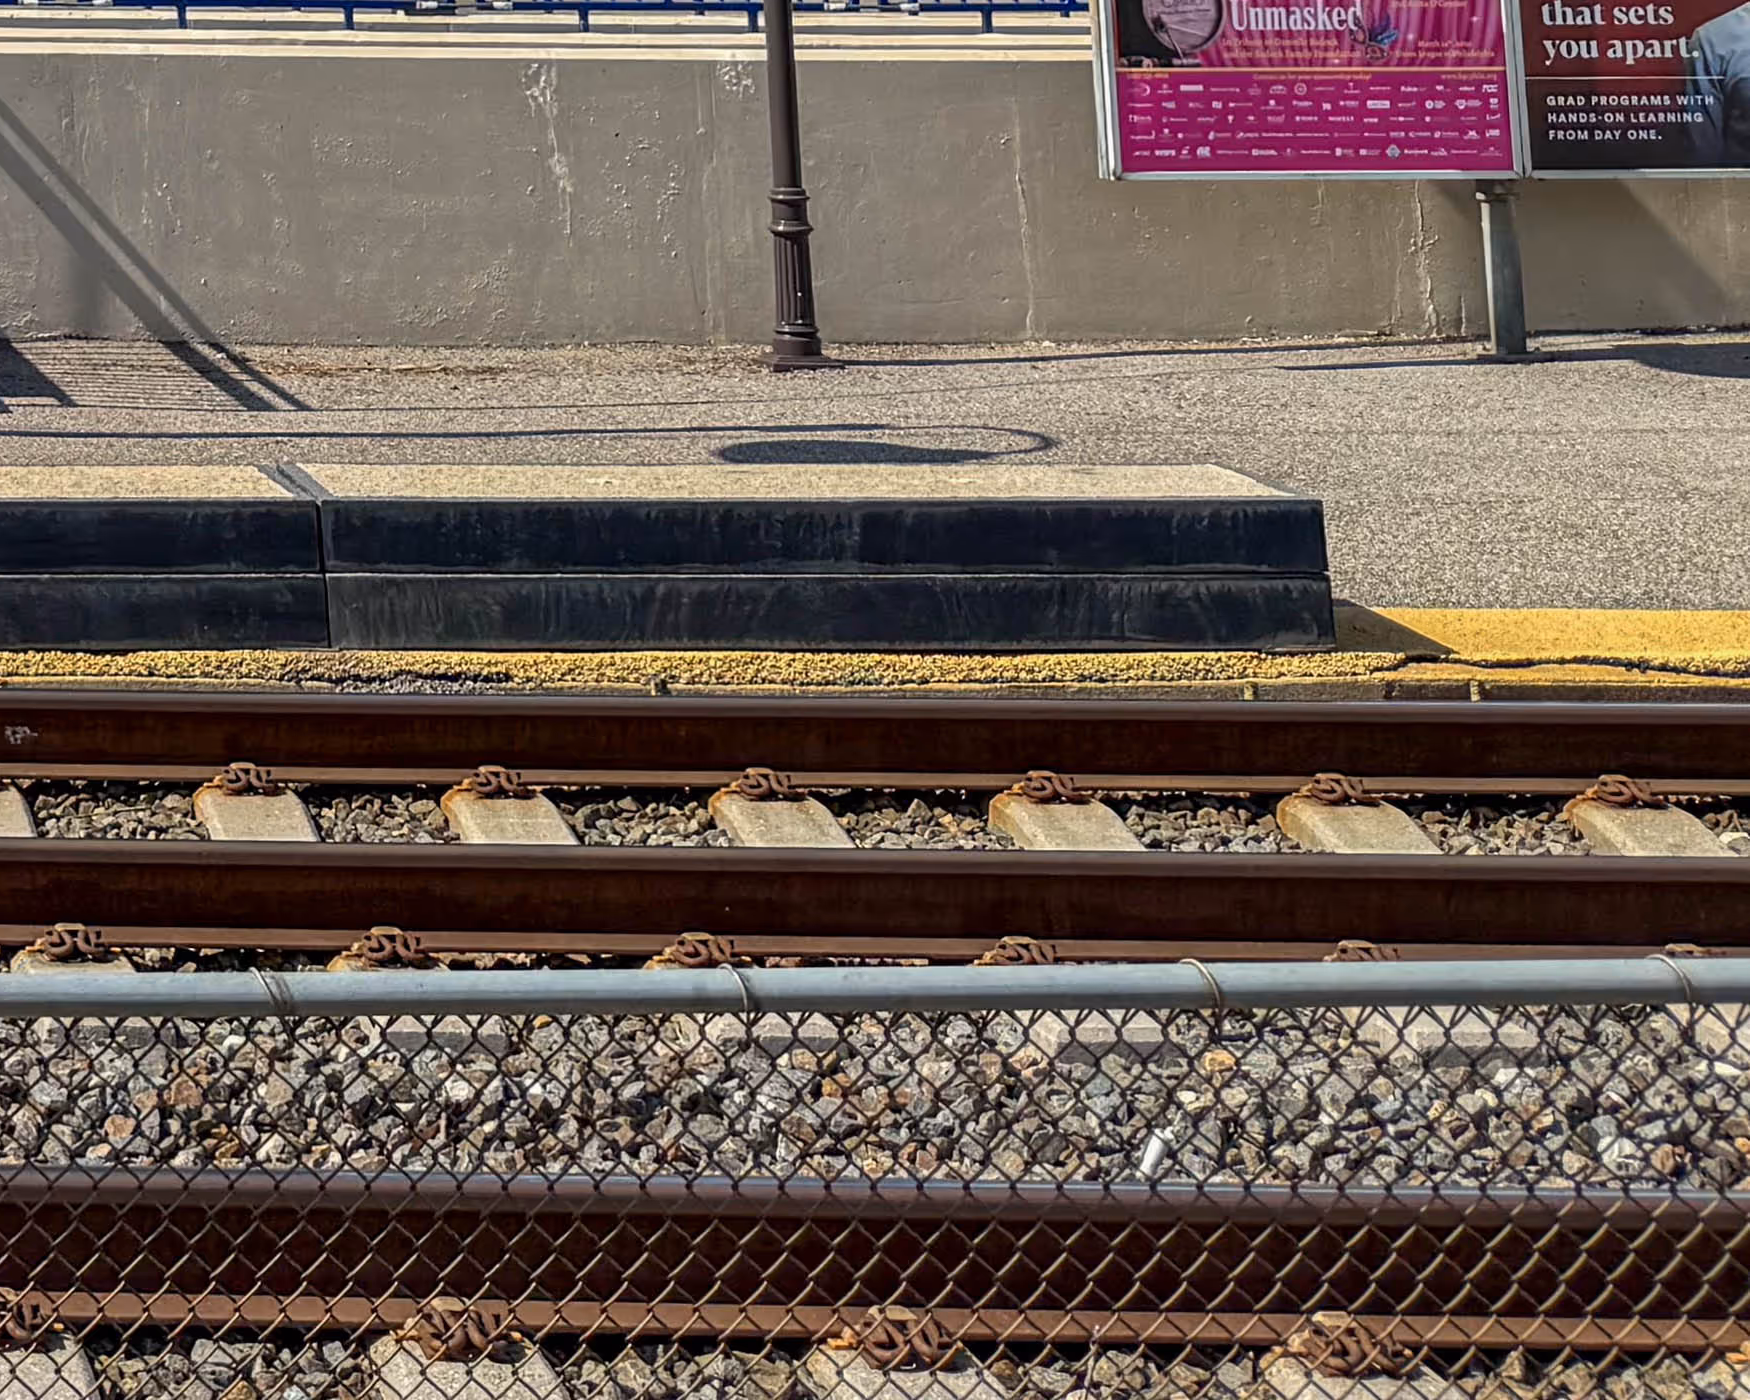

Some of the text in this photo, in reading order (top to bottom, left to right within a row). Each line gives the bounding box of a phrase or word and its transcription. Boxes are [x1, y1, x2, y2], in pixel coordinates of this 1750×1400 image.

[1541, 0, 1676, 26] that sets
[1542, 36, 1700, 66] you apart.
[1546, 94, 1715, 107] GRAD PROGRAMS WITH
[1547, 111, 1705, 124] HANDS-ON LEARNING
[1548, 129, 1664, 141] FROM DAY ONE.
